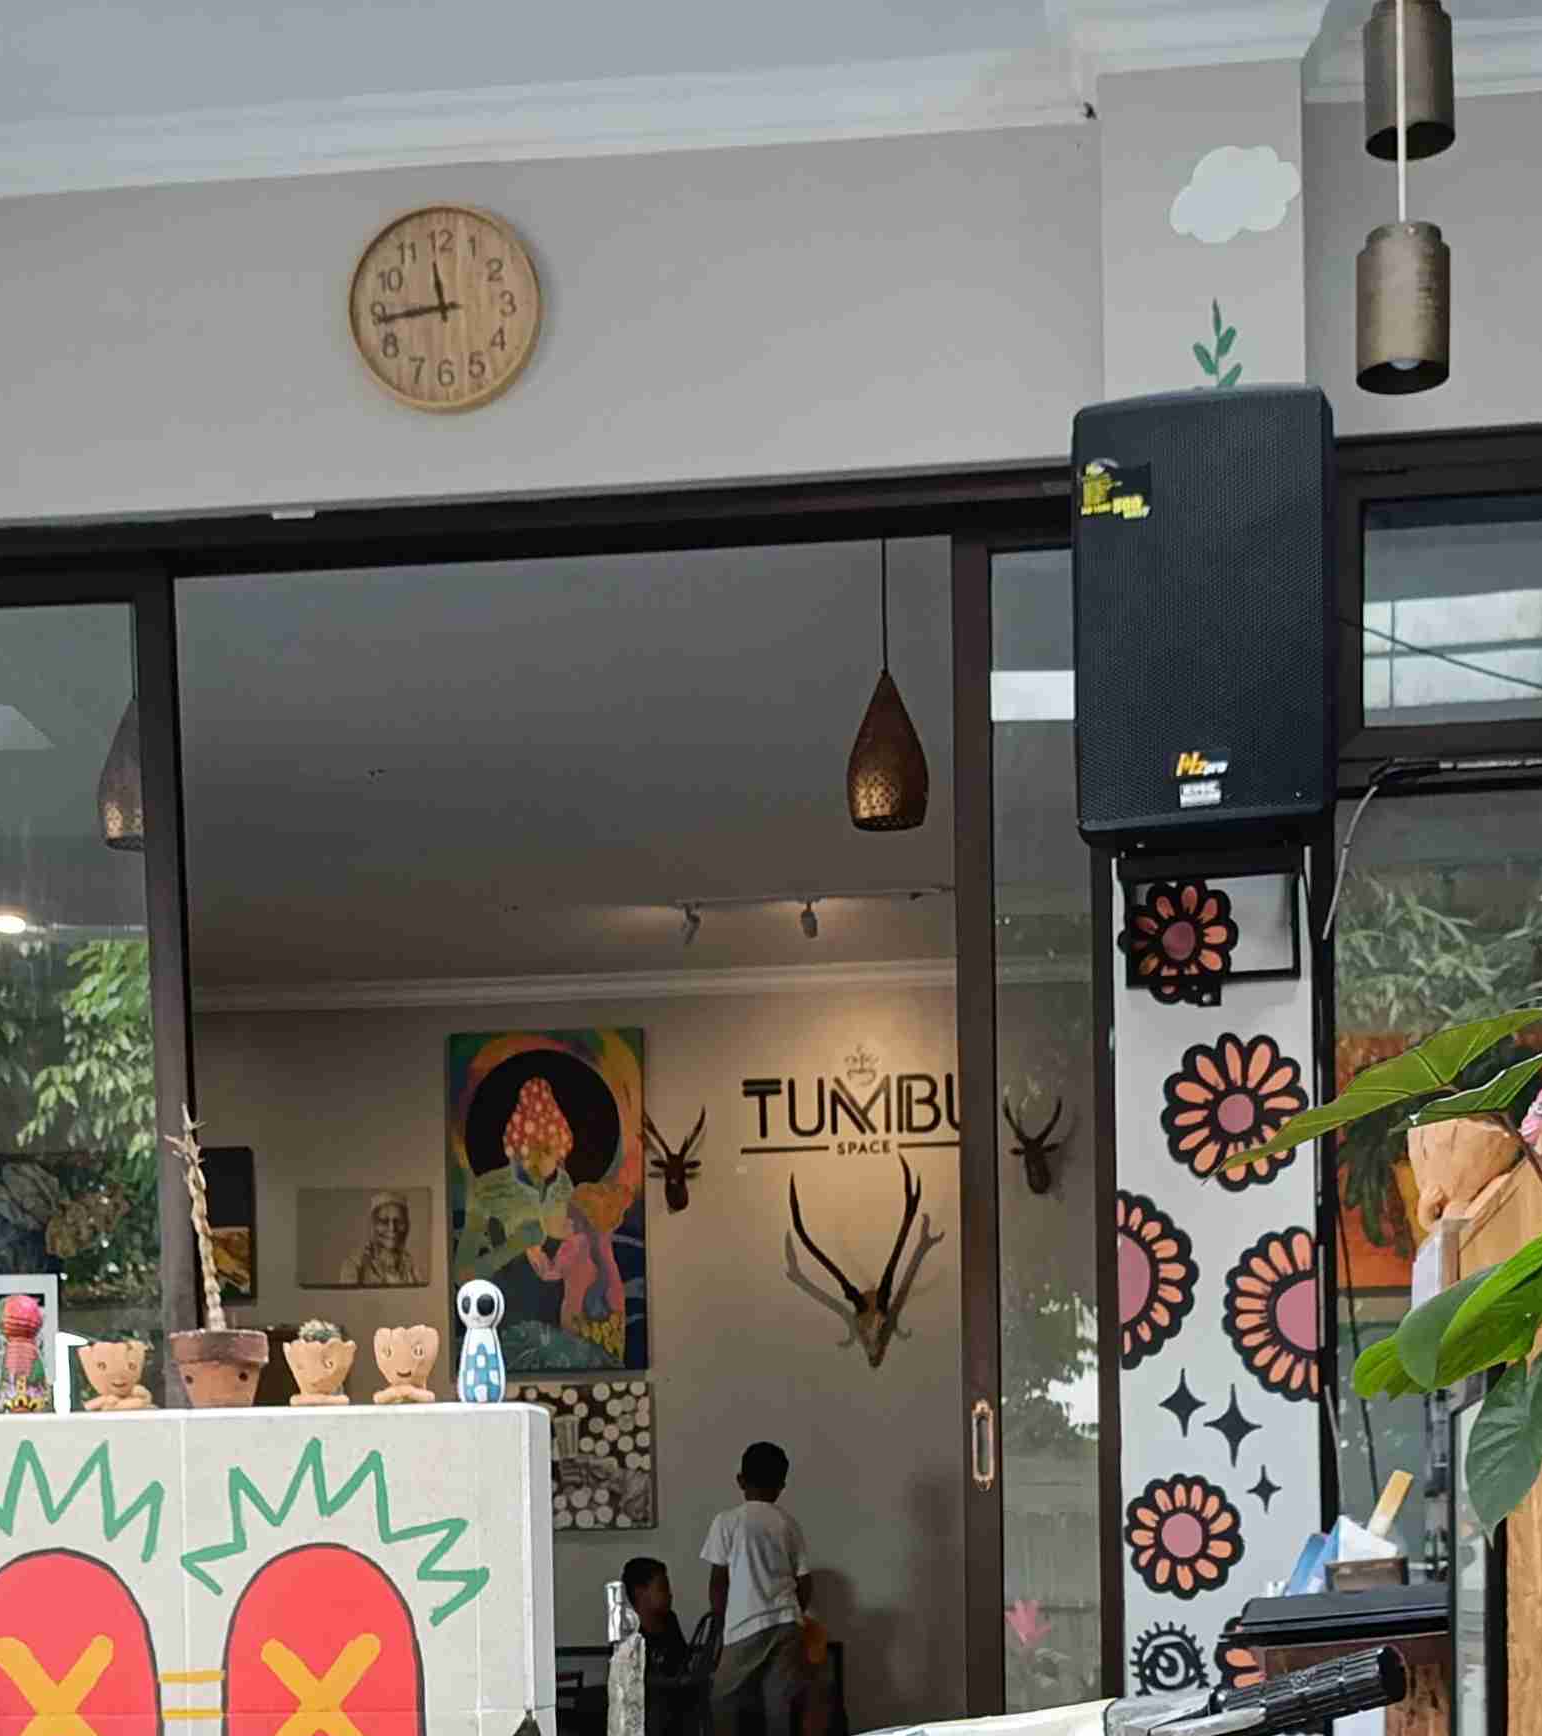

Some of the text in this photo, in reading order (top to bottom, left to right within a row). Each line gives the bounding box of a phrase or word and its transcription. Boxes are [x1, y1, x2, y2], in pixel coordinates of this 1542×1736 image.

[397, 241, 417, 264] 11
[427, 230, 453, 253] 12
[467, 236, 477, 257] 1
[378, 267, 403, 292] 10
[486, 258, 503, 283] 2
[370, 302, 386, 326] 9
[499, 290, 517, 317] 3
[382, 332, 399, 358] 8
[490, 327, 507, 351] 4
[409, 356, 426, 385] 7
[437, 359, 455, 387] 6
[468, 351, 486, 378] 5
[836, 1140, 892, 1156] SPACE
